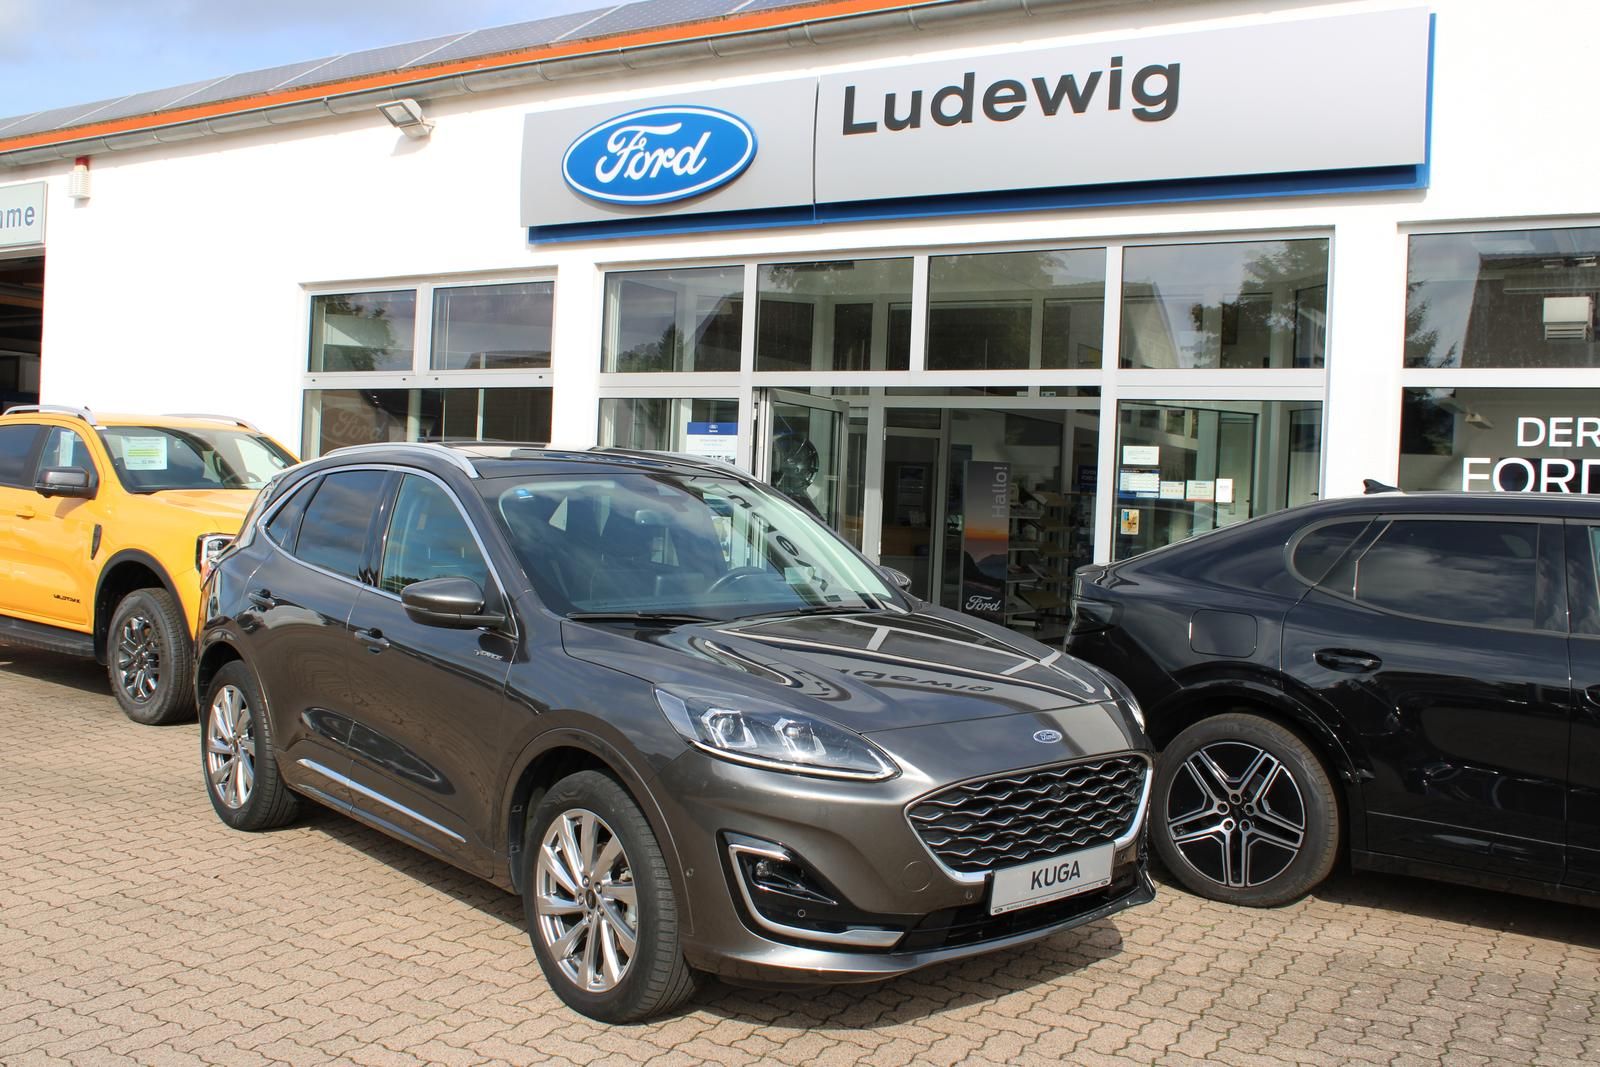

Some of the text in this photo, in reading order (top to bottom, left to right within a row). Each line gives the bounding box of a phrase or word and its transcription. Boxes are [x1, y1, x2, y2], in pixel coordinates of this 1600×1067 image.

[843, 55, 1181, 135] Ludewig
[595, 122, 712, 183] Ford
[1517, 416, 1600, 448] DER
[992, 466, 1008, 518] Hallo!
[965, 595, 1001, 612] Ford
[1031, 860, 1081, 891] KUGA
